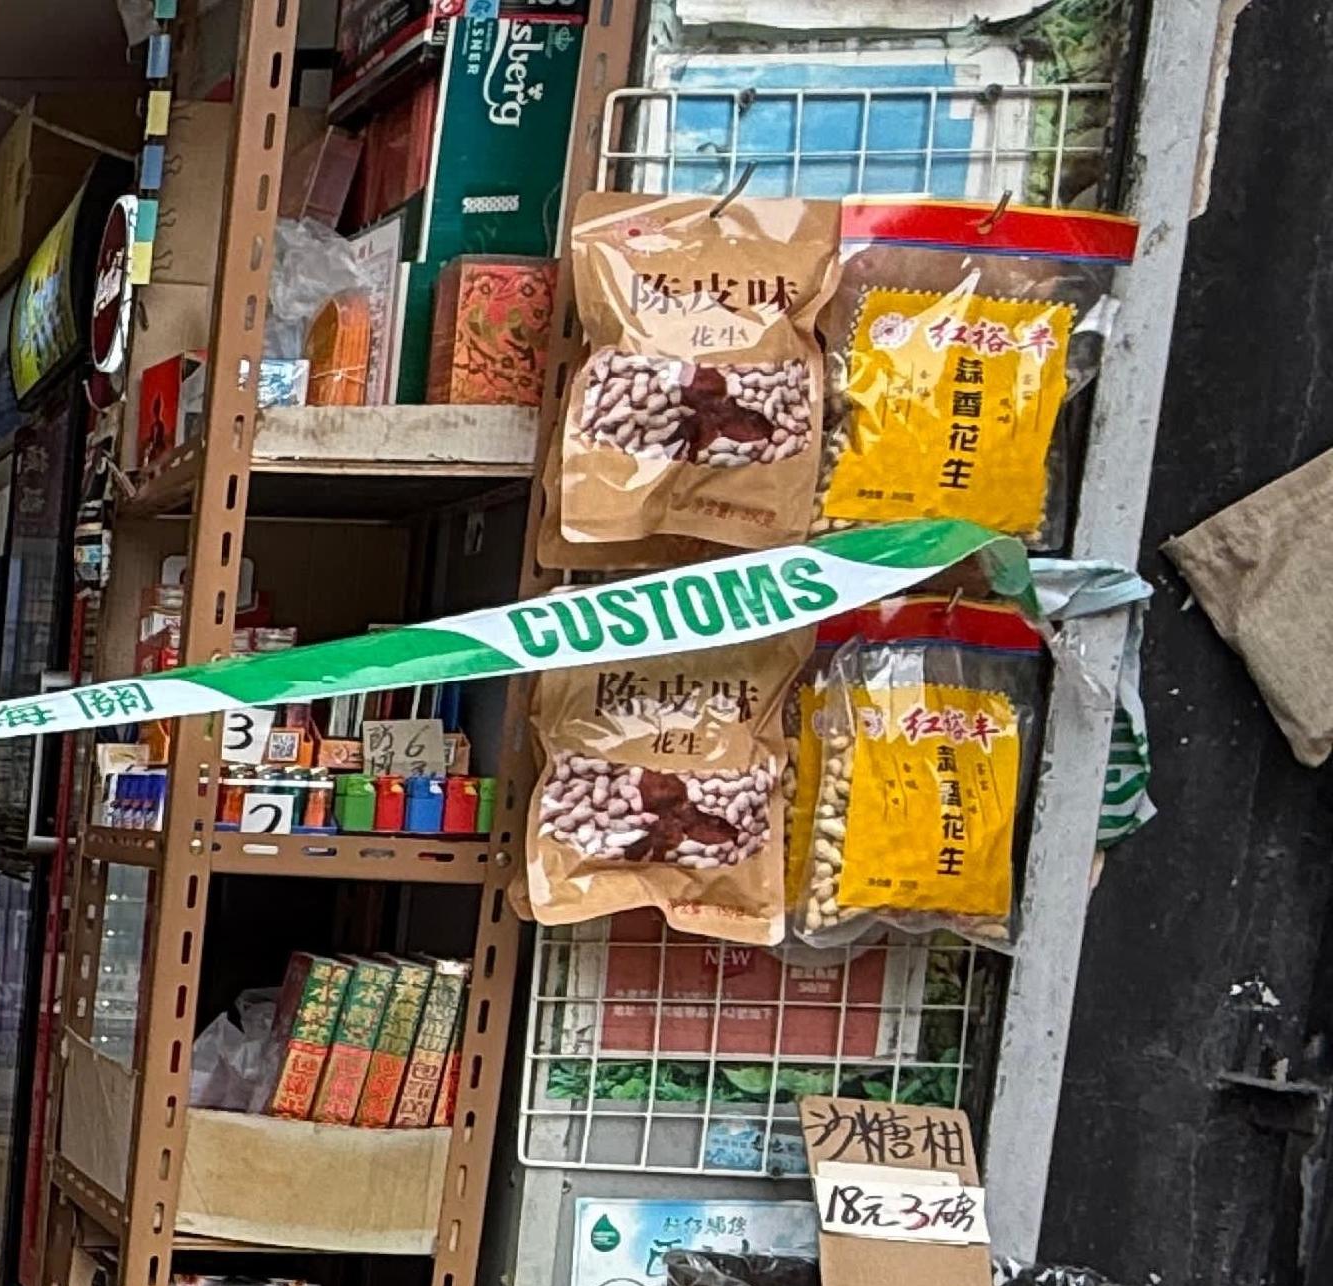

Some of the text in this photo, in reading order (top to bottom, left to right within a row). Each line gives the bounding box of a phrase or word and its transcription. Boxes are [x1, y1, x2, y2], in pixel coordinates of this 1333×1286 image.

[631, 272, 800, 318] 陈皮味
[929, 316, 1056, 358] 红裕丰
[938, 355, 985, 490] 蒜香花生
[508, 557, 839, 659] CUSTOMS
[594, 671, 758, 722] 陈皮味
[225, 714, 254, 751] 3
[651, 732, 703, 756] 花生
[804, 1104, 966, 1168] 沙糖柑
[824, 1184, 979, 1232] 18元3磅
